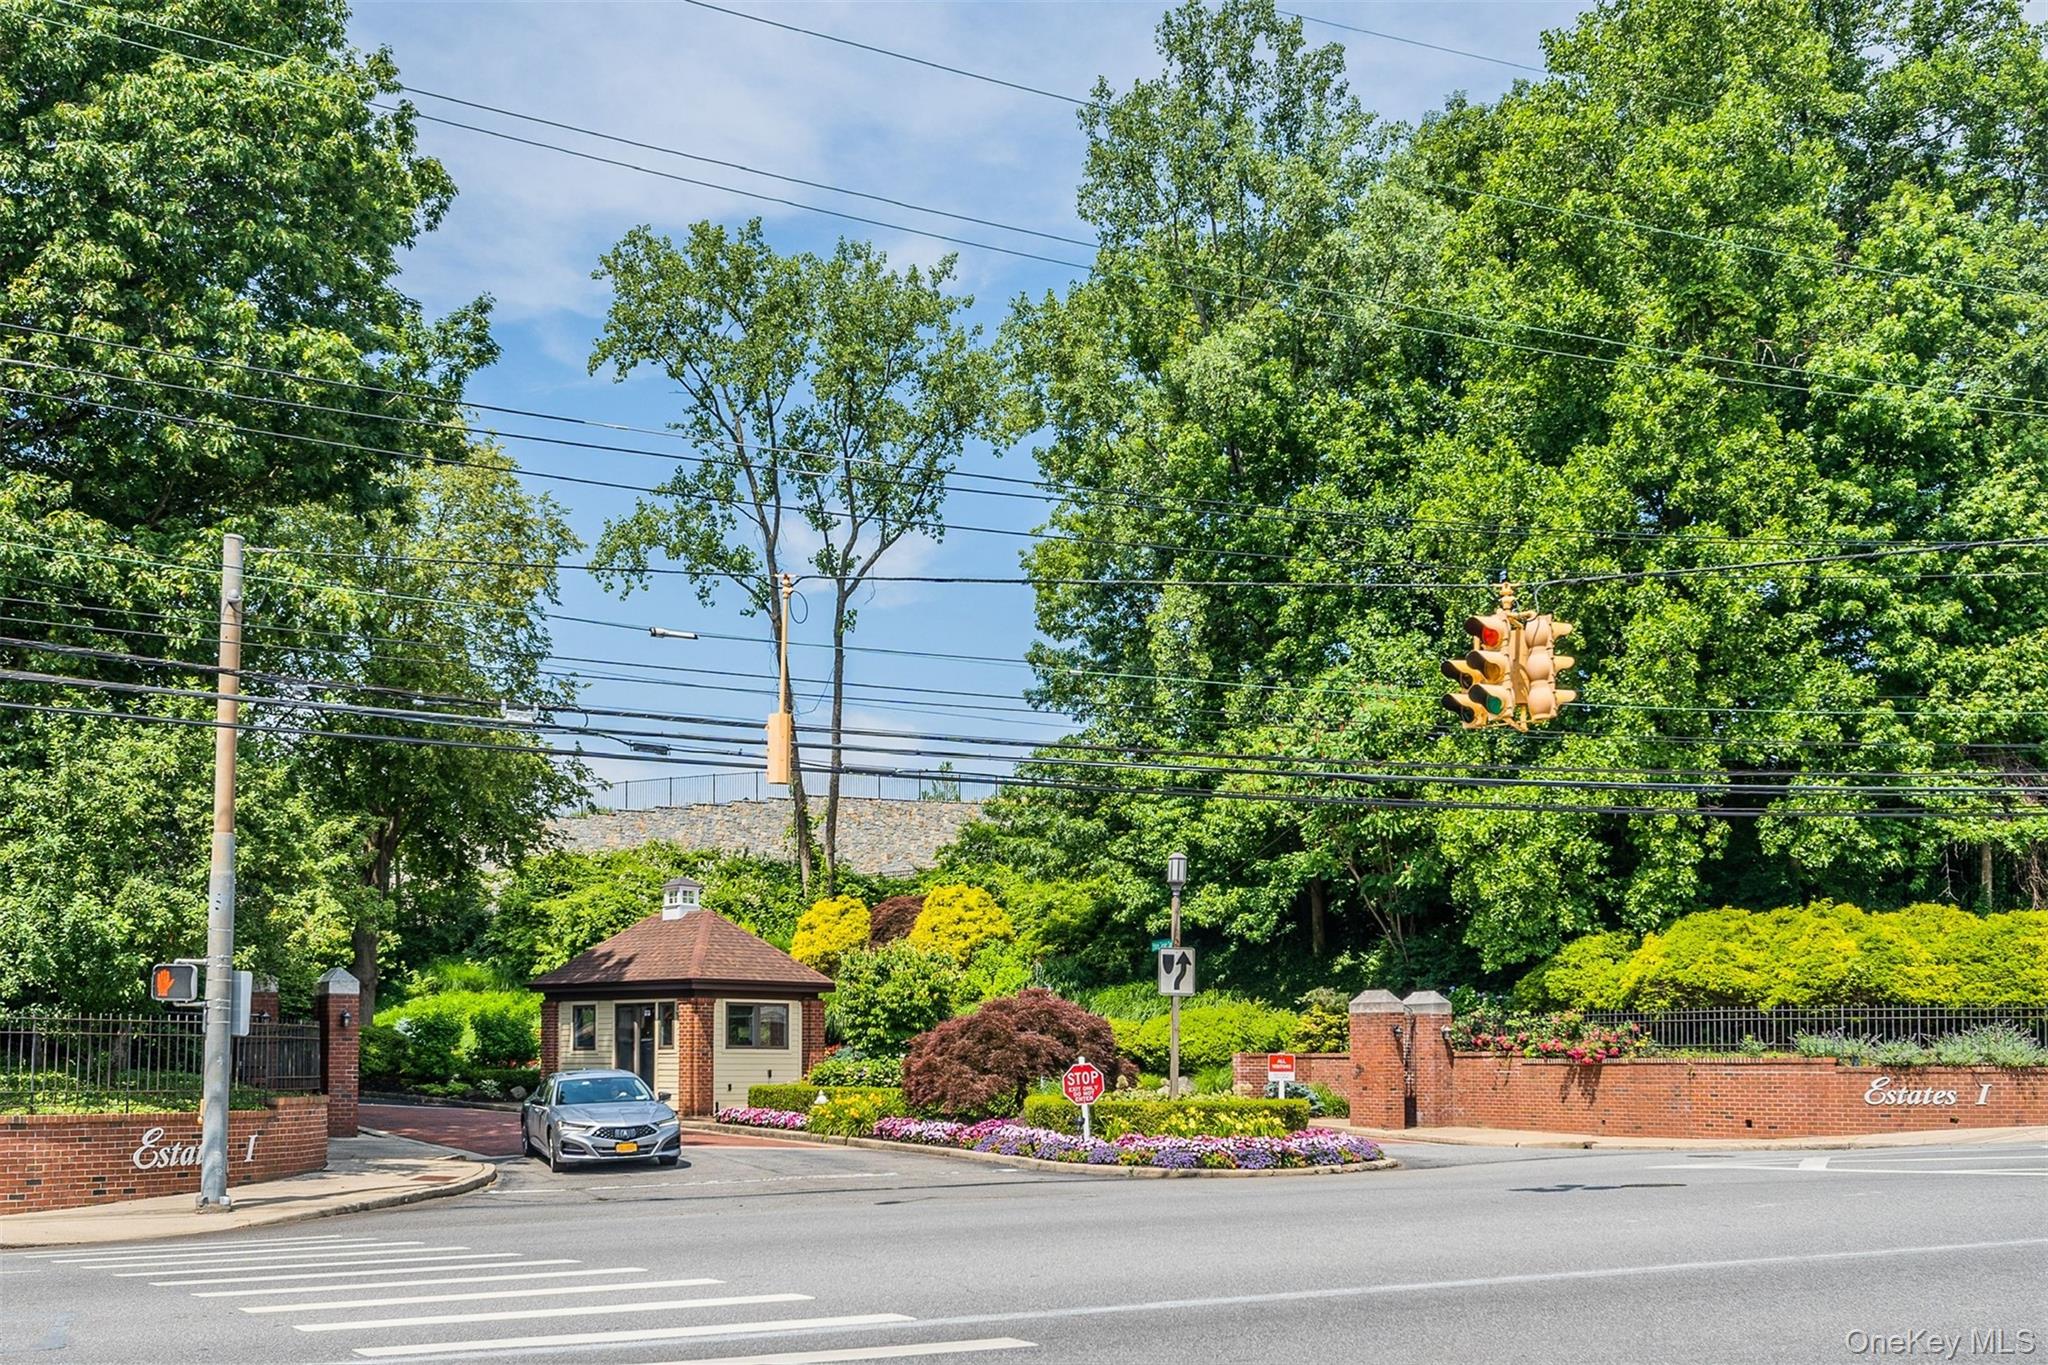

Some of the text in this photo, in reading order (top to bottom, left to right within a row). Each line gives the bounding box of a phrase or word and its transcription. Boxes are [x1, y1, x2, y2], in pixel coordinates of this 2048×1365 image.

[1067, 1071, 1099, 1086] STOP
[1864, 1076, 1993, 1107] Estates I
[244, 1134, 259, 1163] I
